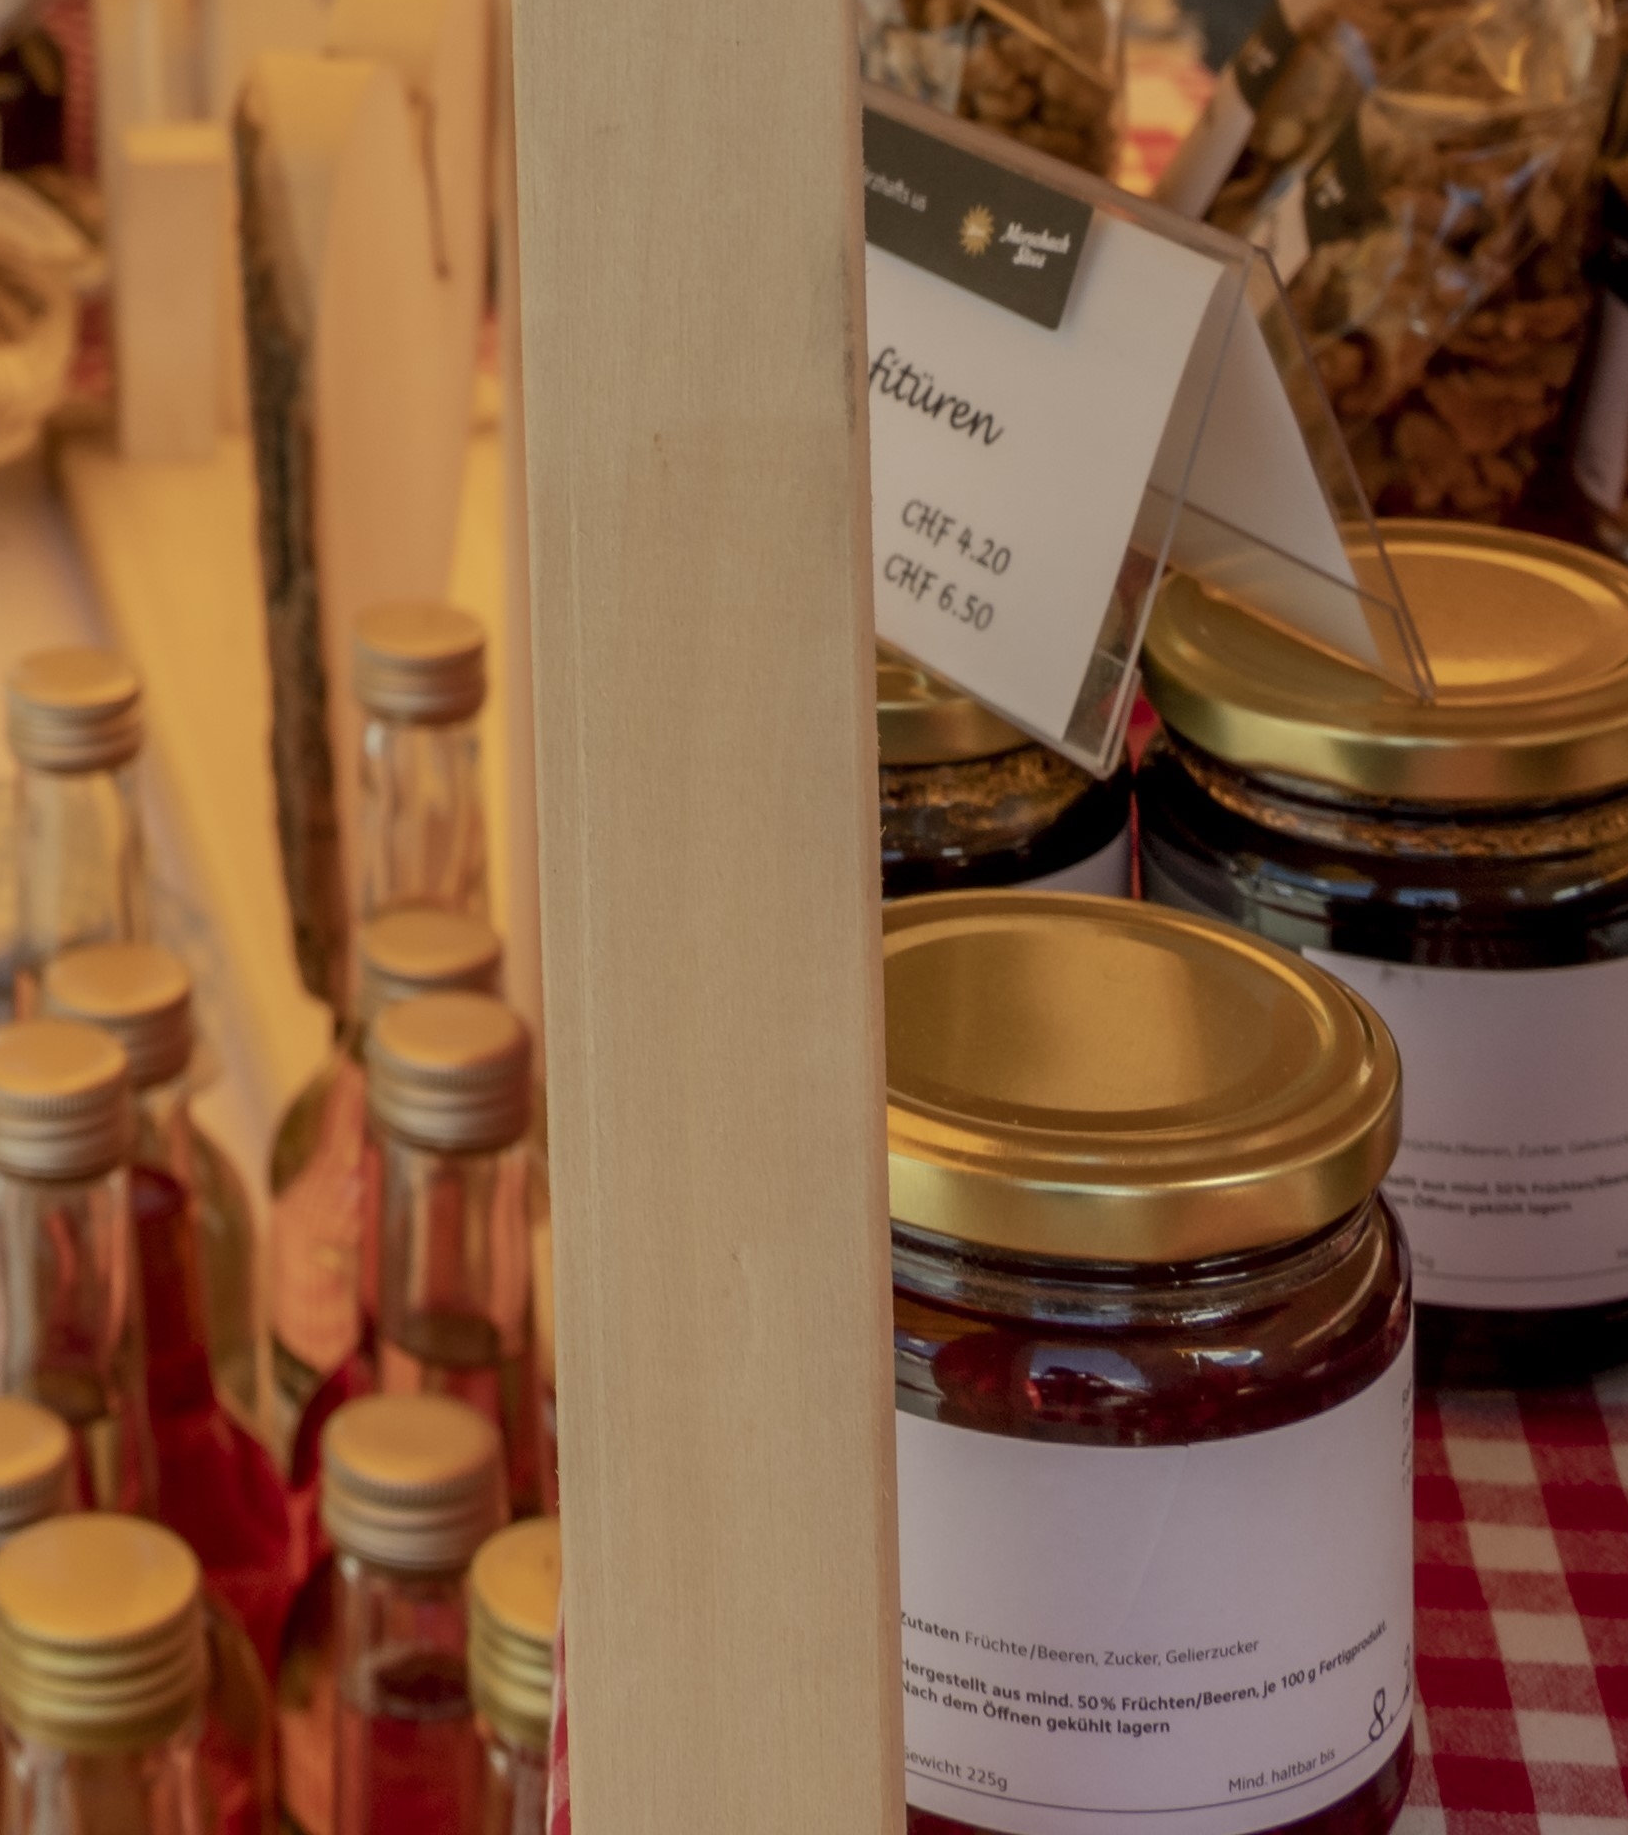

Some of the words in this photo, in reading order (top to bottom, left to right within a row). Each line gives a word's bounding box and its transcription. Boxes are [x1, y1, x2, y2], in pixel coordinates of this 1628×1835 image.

[901, 498, 956, 547] CHF
[957, 526, 1012, 576] 4.20
[883, 552, 939, 602] CHF
[938, 582, 994, 632] 6.50
[965, 1631, 1099, 1667] Früchte/Beeren,
[1104, 1650, 1161, 1666] Zucker,
[1166, 1639, 1259, 1665] Gelierzucker
[992, 1685, 1021, 1701] aus
[1026, 1690, 1073, 1709] mind.
[1122, 1681, 1260, 1711] Früchten/Beeren,
[1262, 1680, 1277, 1700] je
[1281, 1670, 1305, 1690] 100
[1308, 1668, 1316, 1683] g
[1319, 1619, 1387, 1676] Fertigprodukt
[942, 1695, 978, 1714] dem
[983, 1700, 1041, 1727] Öffnen
[1046, 1715, 1112, 1733] gekühlt
[1117, 1720, 1170, 1737] lagern
[967, 1766, 1008, 1792] 225g
[1228, 1771, 1269, 1793] Mind.
[1271, 1758, 1318, 1784] haltbar
[1319, 1747, 1336, 1765] bis
